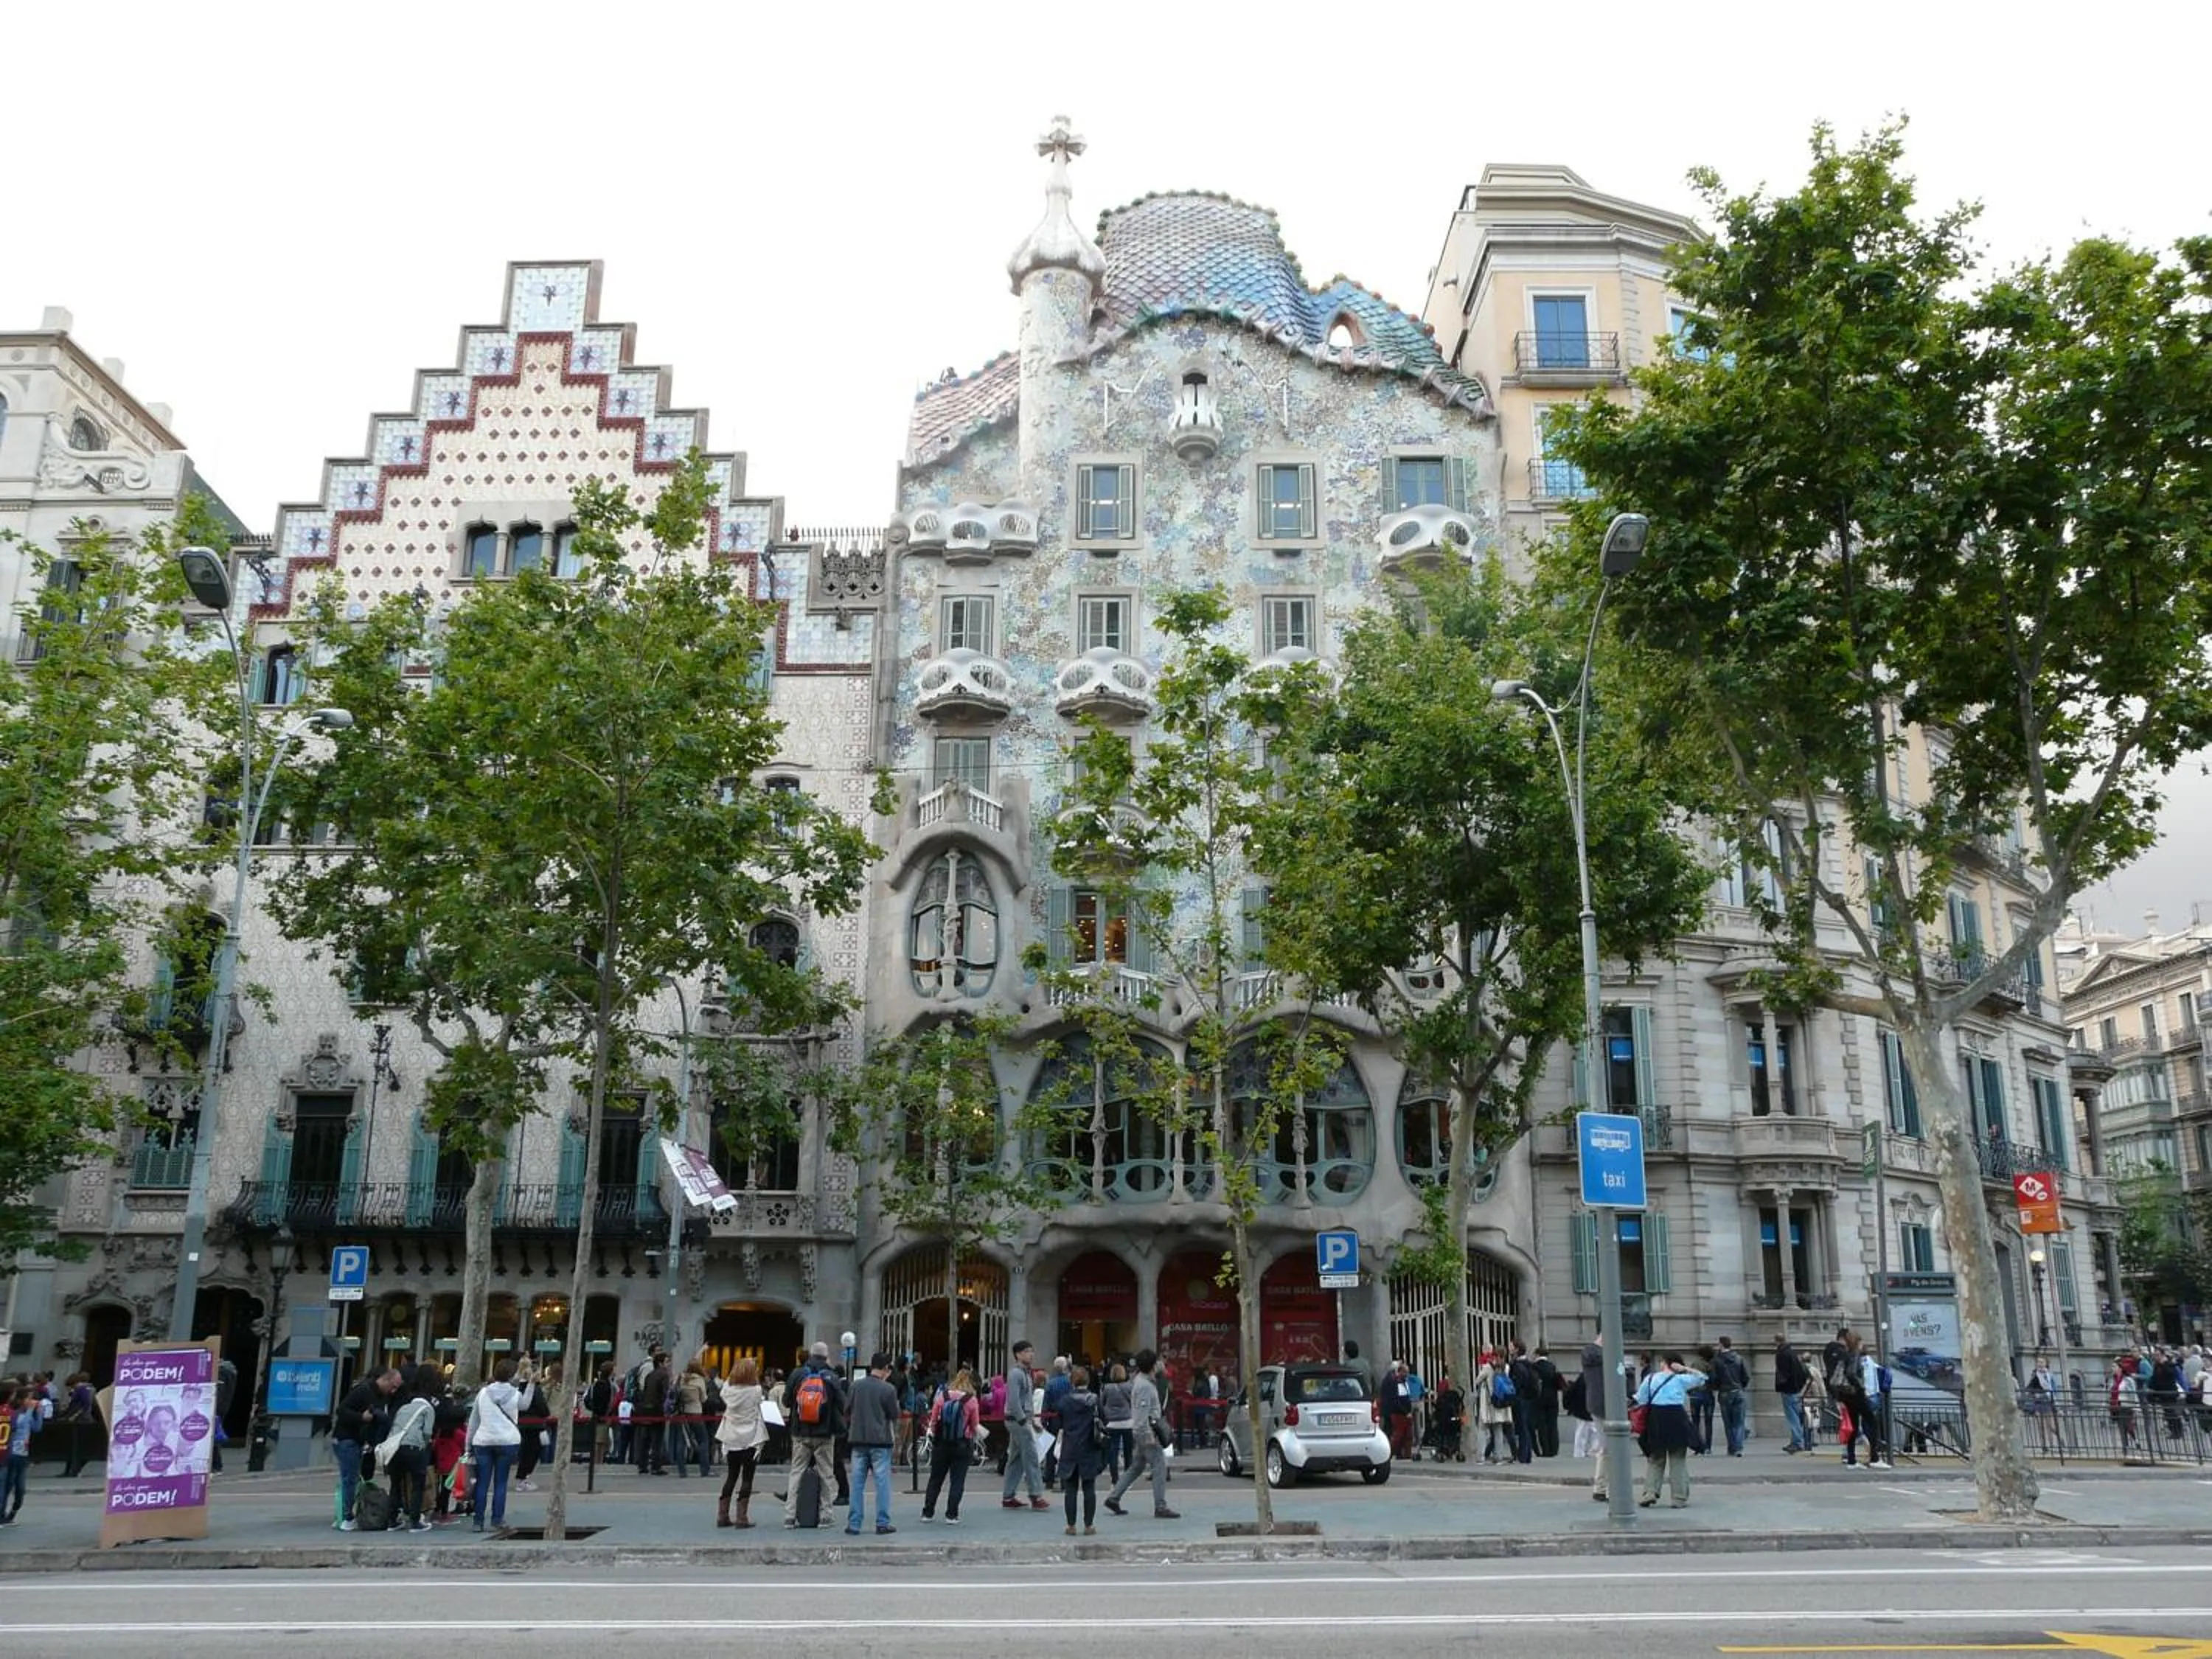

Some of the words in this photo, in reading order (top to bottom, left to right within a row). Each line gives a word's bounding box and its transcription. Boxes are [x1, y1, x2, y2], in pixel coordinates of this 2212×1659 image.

[1602, 1170, 1626, 1188] taxi
[1326, 1237, 1349, 1269] P
[337, 1252, 360, 1282] P
[119, 1365, 184, 1382] PODEM!
[111, 1489, 178, 1506] PODEM!
